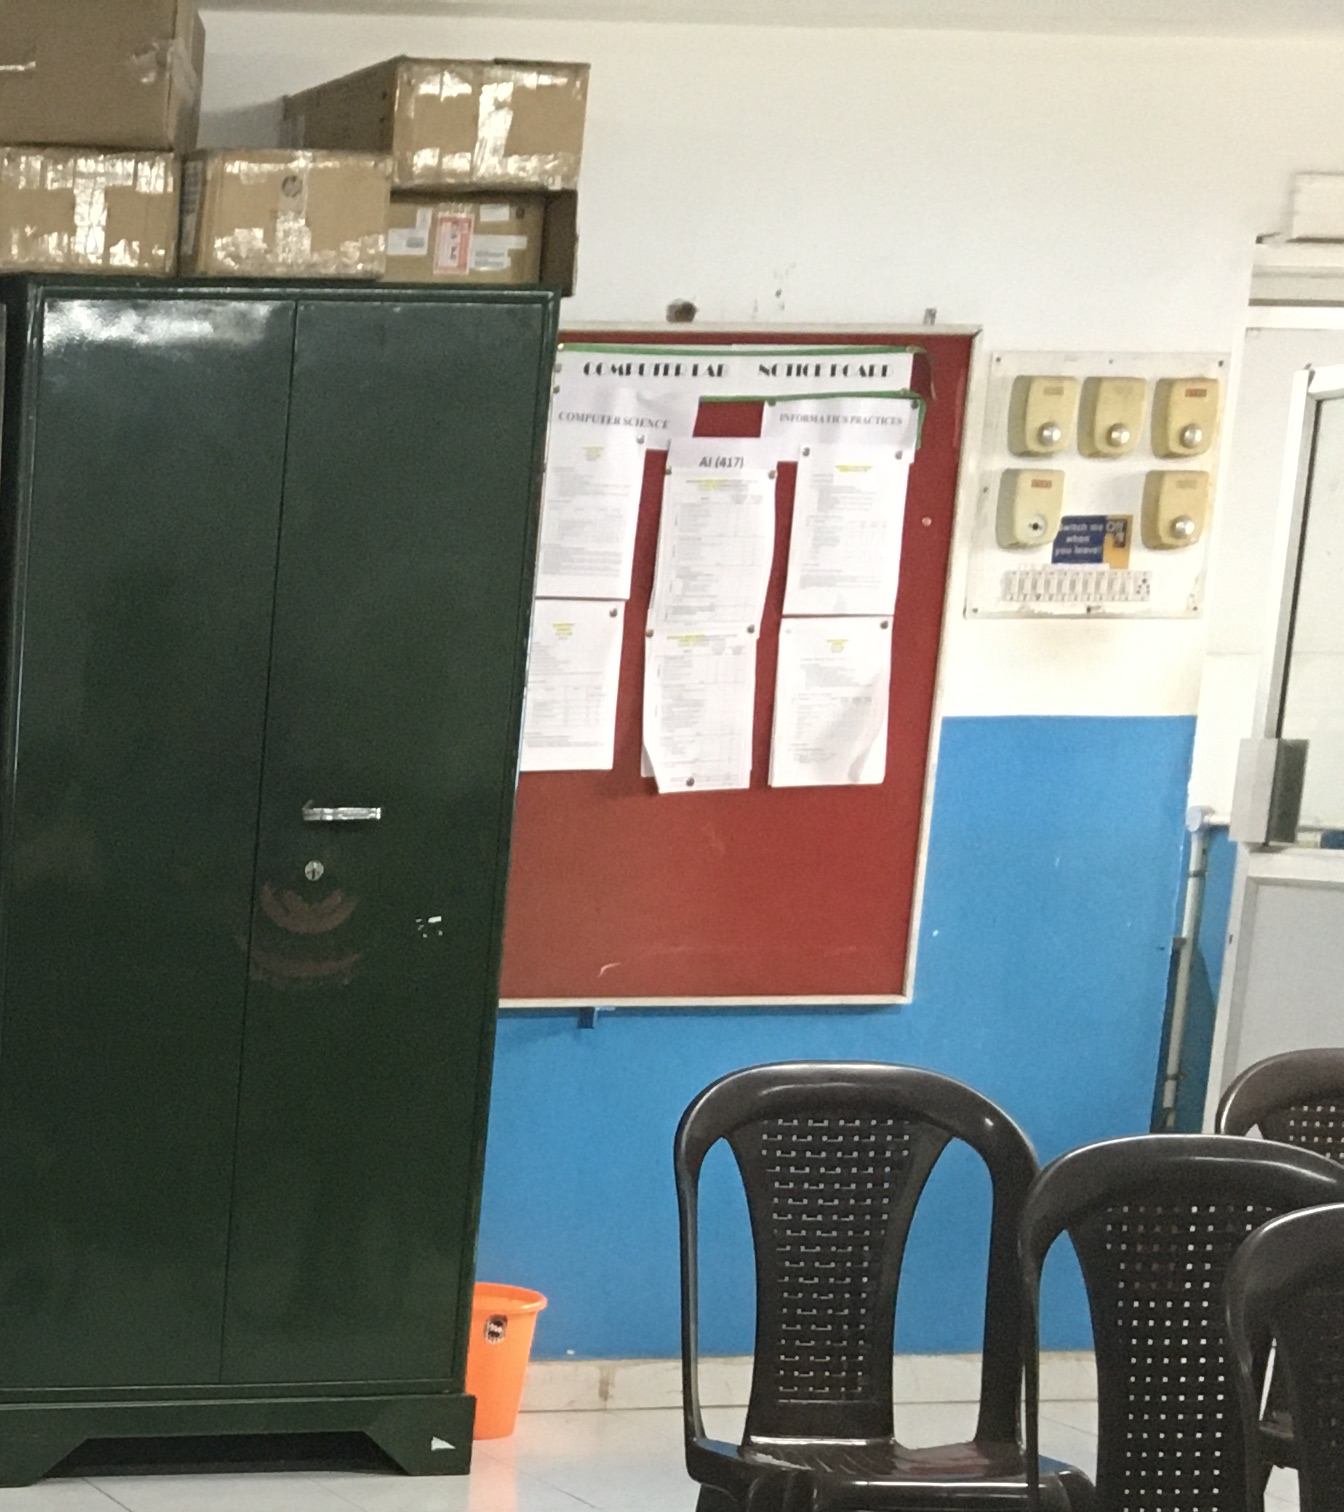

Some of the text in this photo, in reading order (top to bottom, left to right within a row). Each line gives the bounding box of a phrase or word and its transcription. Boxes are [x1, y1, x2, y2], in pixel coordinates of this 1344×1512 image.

[583, 361, 894, 378] COMPUTER LAB NOTICE BOARD
[558, 410, 670, 430] COMPUTER SCIENCE
[779, 412, 903, 426] INFORMATICS PRACTICES
[698, 455, 745, 469] AI (417)
